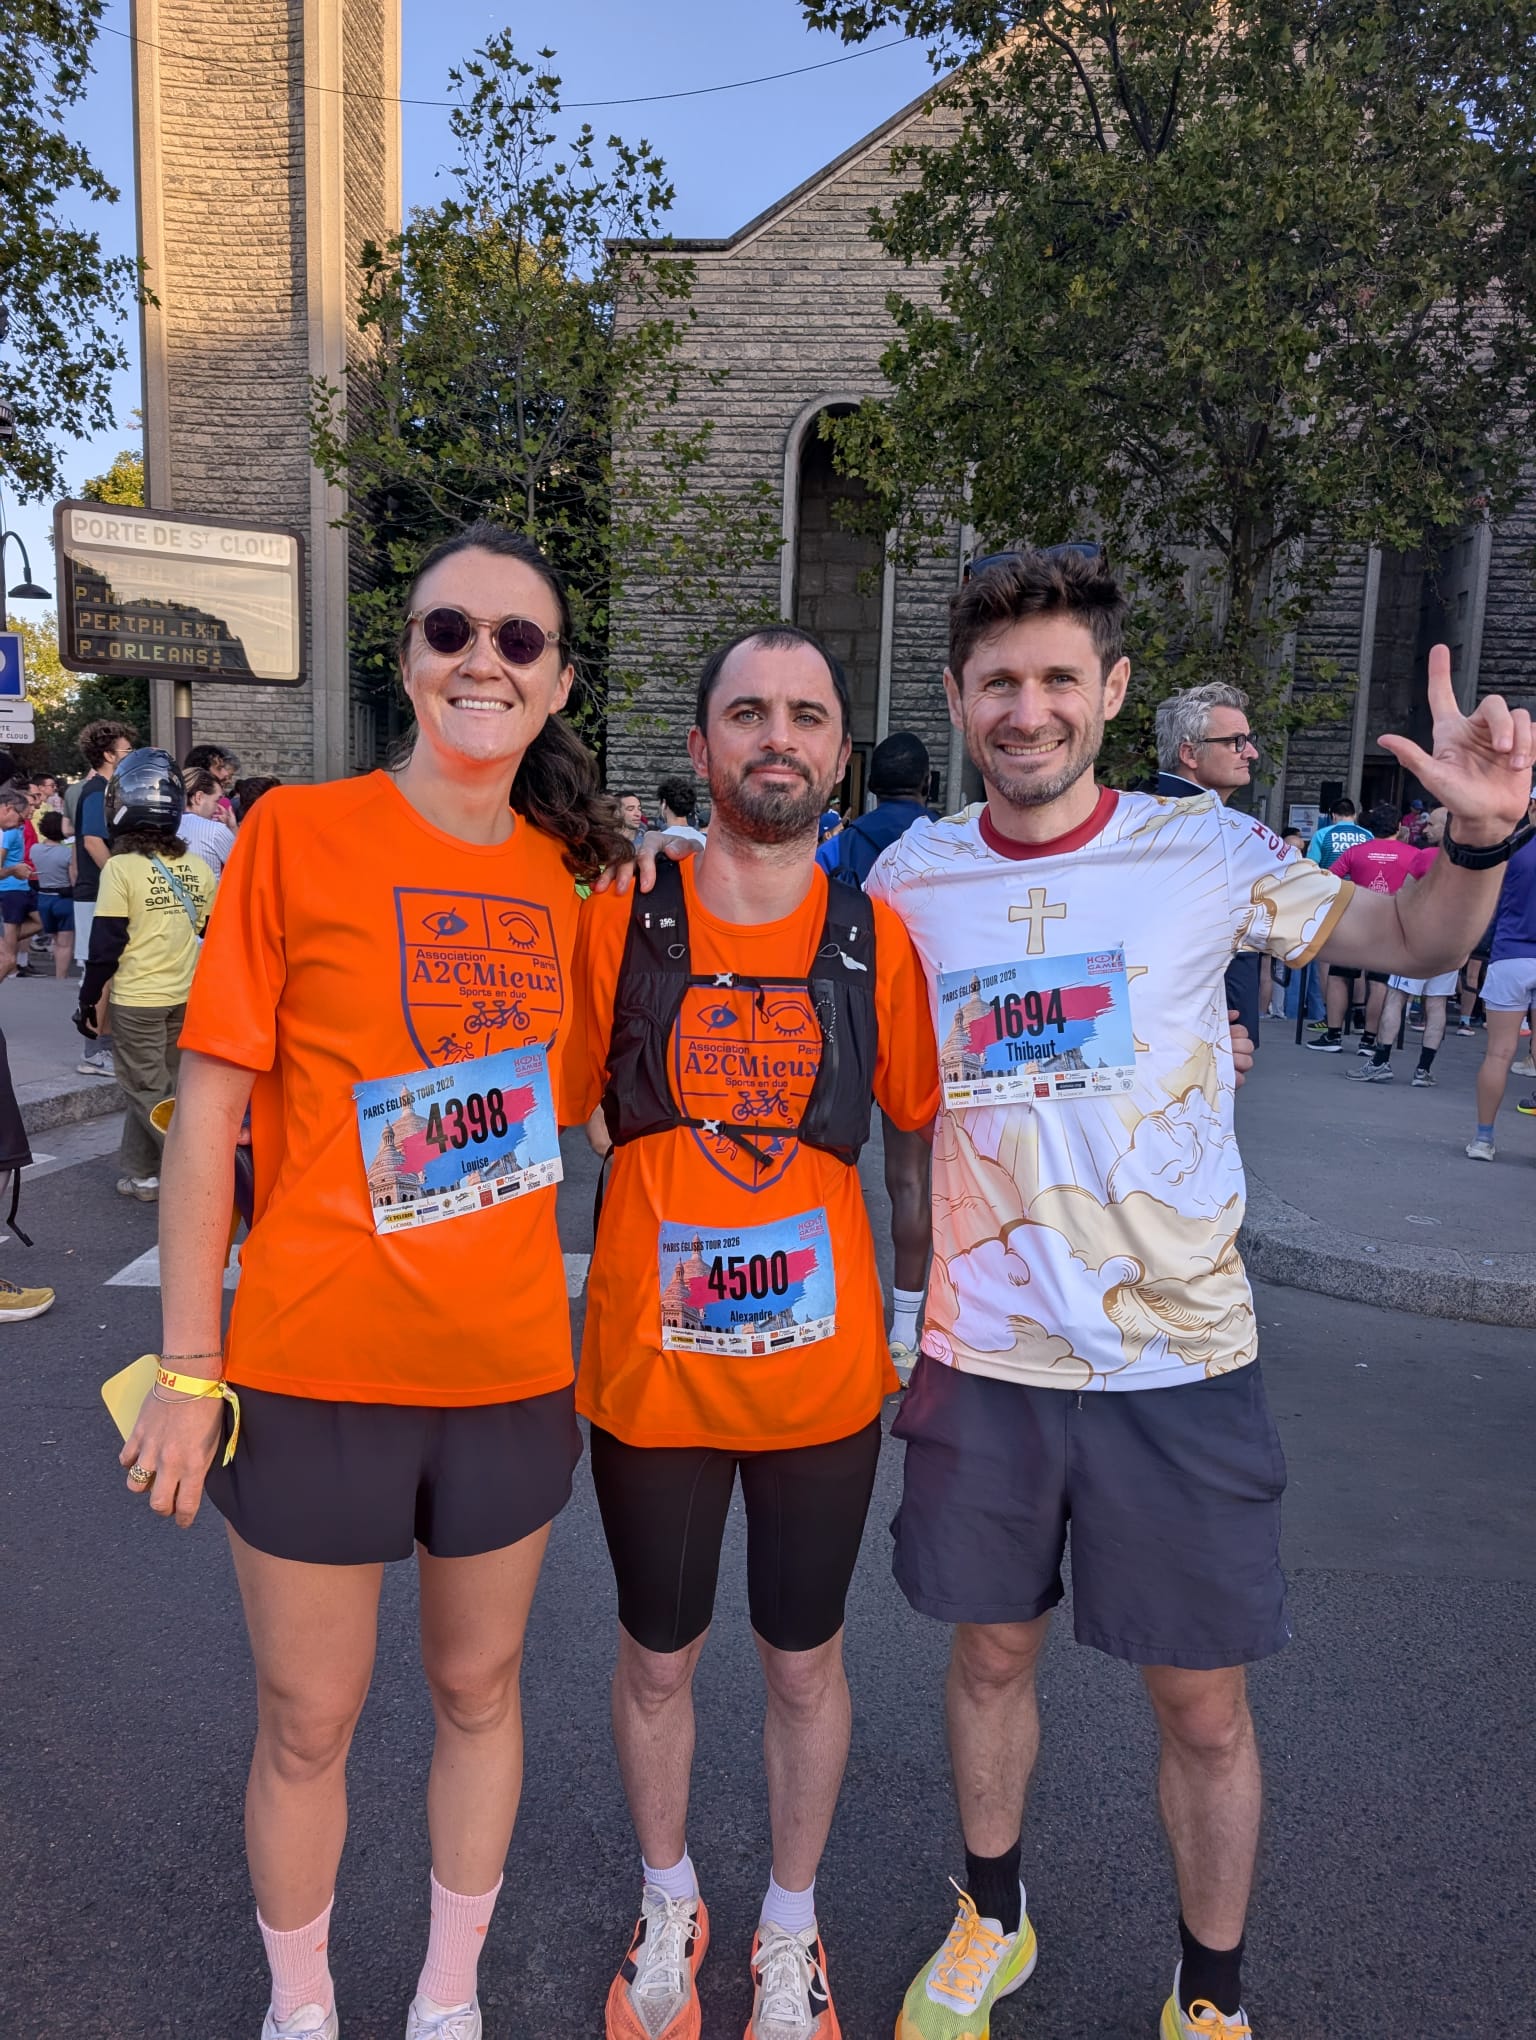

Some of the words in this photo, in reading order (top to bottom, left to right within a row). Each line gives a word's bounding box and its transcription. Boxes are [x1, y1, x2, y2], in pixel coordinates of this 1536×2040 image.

[73, 517, 147, 544] PORTE
[153, 526, 182, 547] DE
[1331, 832, 1367, 843] PARIS
[176, 865, 192, 873] TA
[145, 896, 170, 907] SON
[415, 949, 486, 963] Association
[532, 957, 556, 971] Paris
[1088, 961, 1125, 970] GAMES
[412, 960, 557, 993] A2CMieux
[942, 989, 959, 1004] PARIS
[982, 974, 999, 989] TOUR
[999, 968, 1017, 983] 2026
[458, 986, 492, 999] Sports
[495, 990, 507, 998] en
[510, 990, 527, 999] duo
[989, 988, 1067, 1041] 1694
[688, 1041, 750, 1054] Association
[1005, 1039, 1058, 1062] Thibaut
[684, 1052, 819, 1078] A2CMieux
[725, 1077, 756, 1088] Sports
[772, 1079, 788, 1088] duo
[363, 1103, 386, 1120] PARIS
[386, 1092, 415, 1112] ÉGLISES
[416, 1083, 436, 1100] TOUR
[436, 1076, 455, 1092] 2026
[425, 1087, 508, 1154] 4398
[461, 1155, 490, 1175] Louise
[662, 1242, 680, 1253] PARIS
[705, 1240, 722, 1251] TOUR
[723, 1236, 740, 1249] 2026
[707, 1250, 789, 1301] 4500
[730, 1309, 773, 1323] Alexandre
